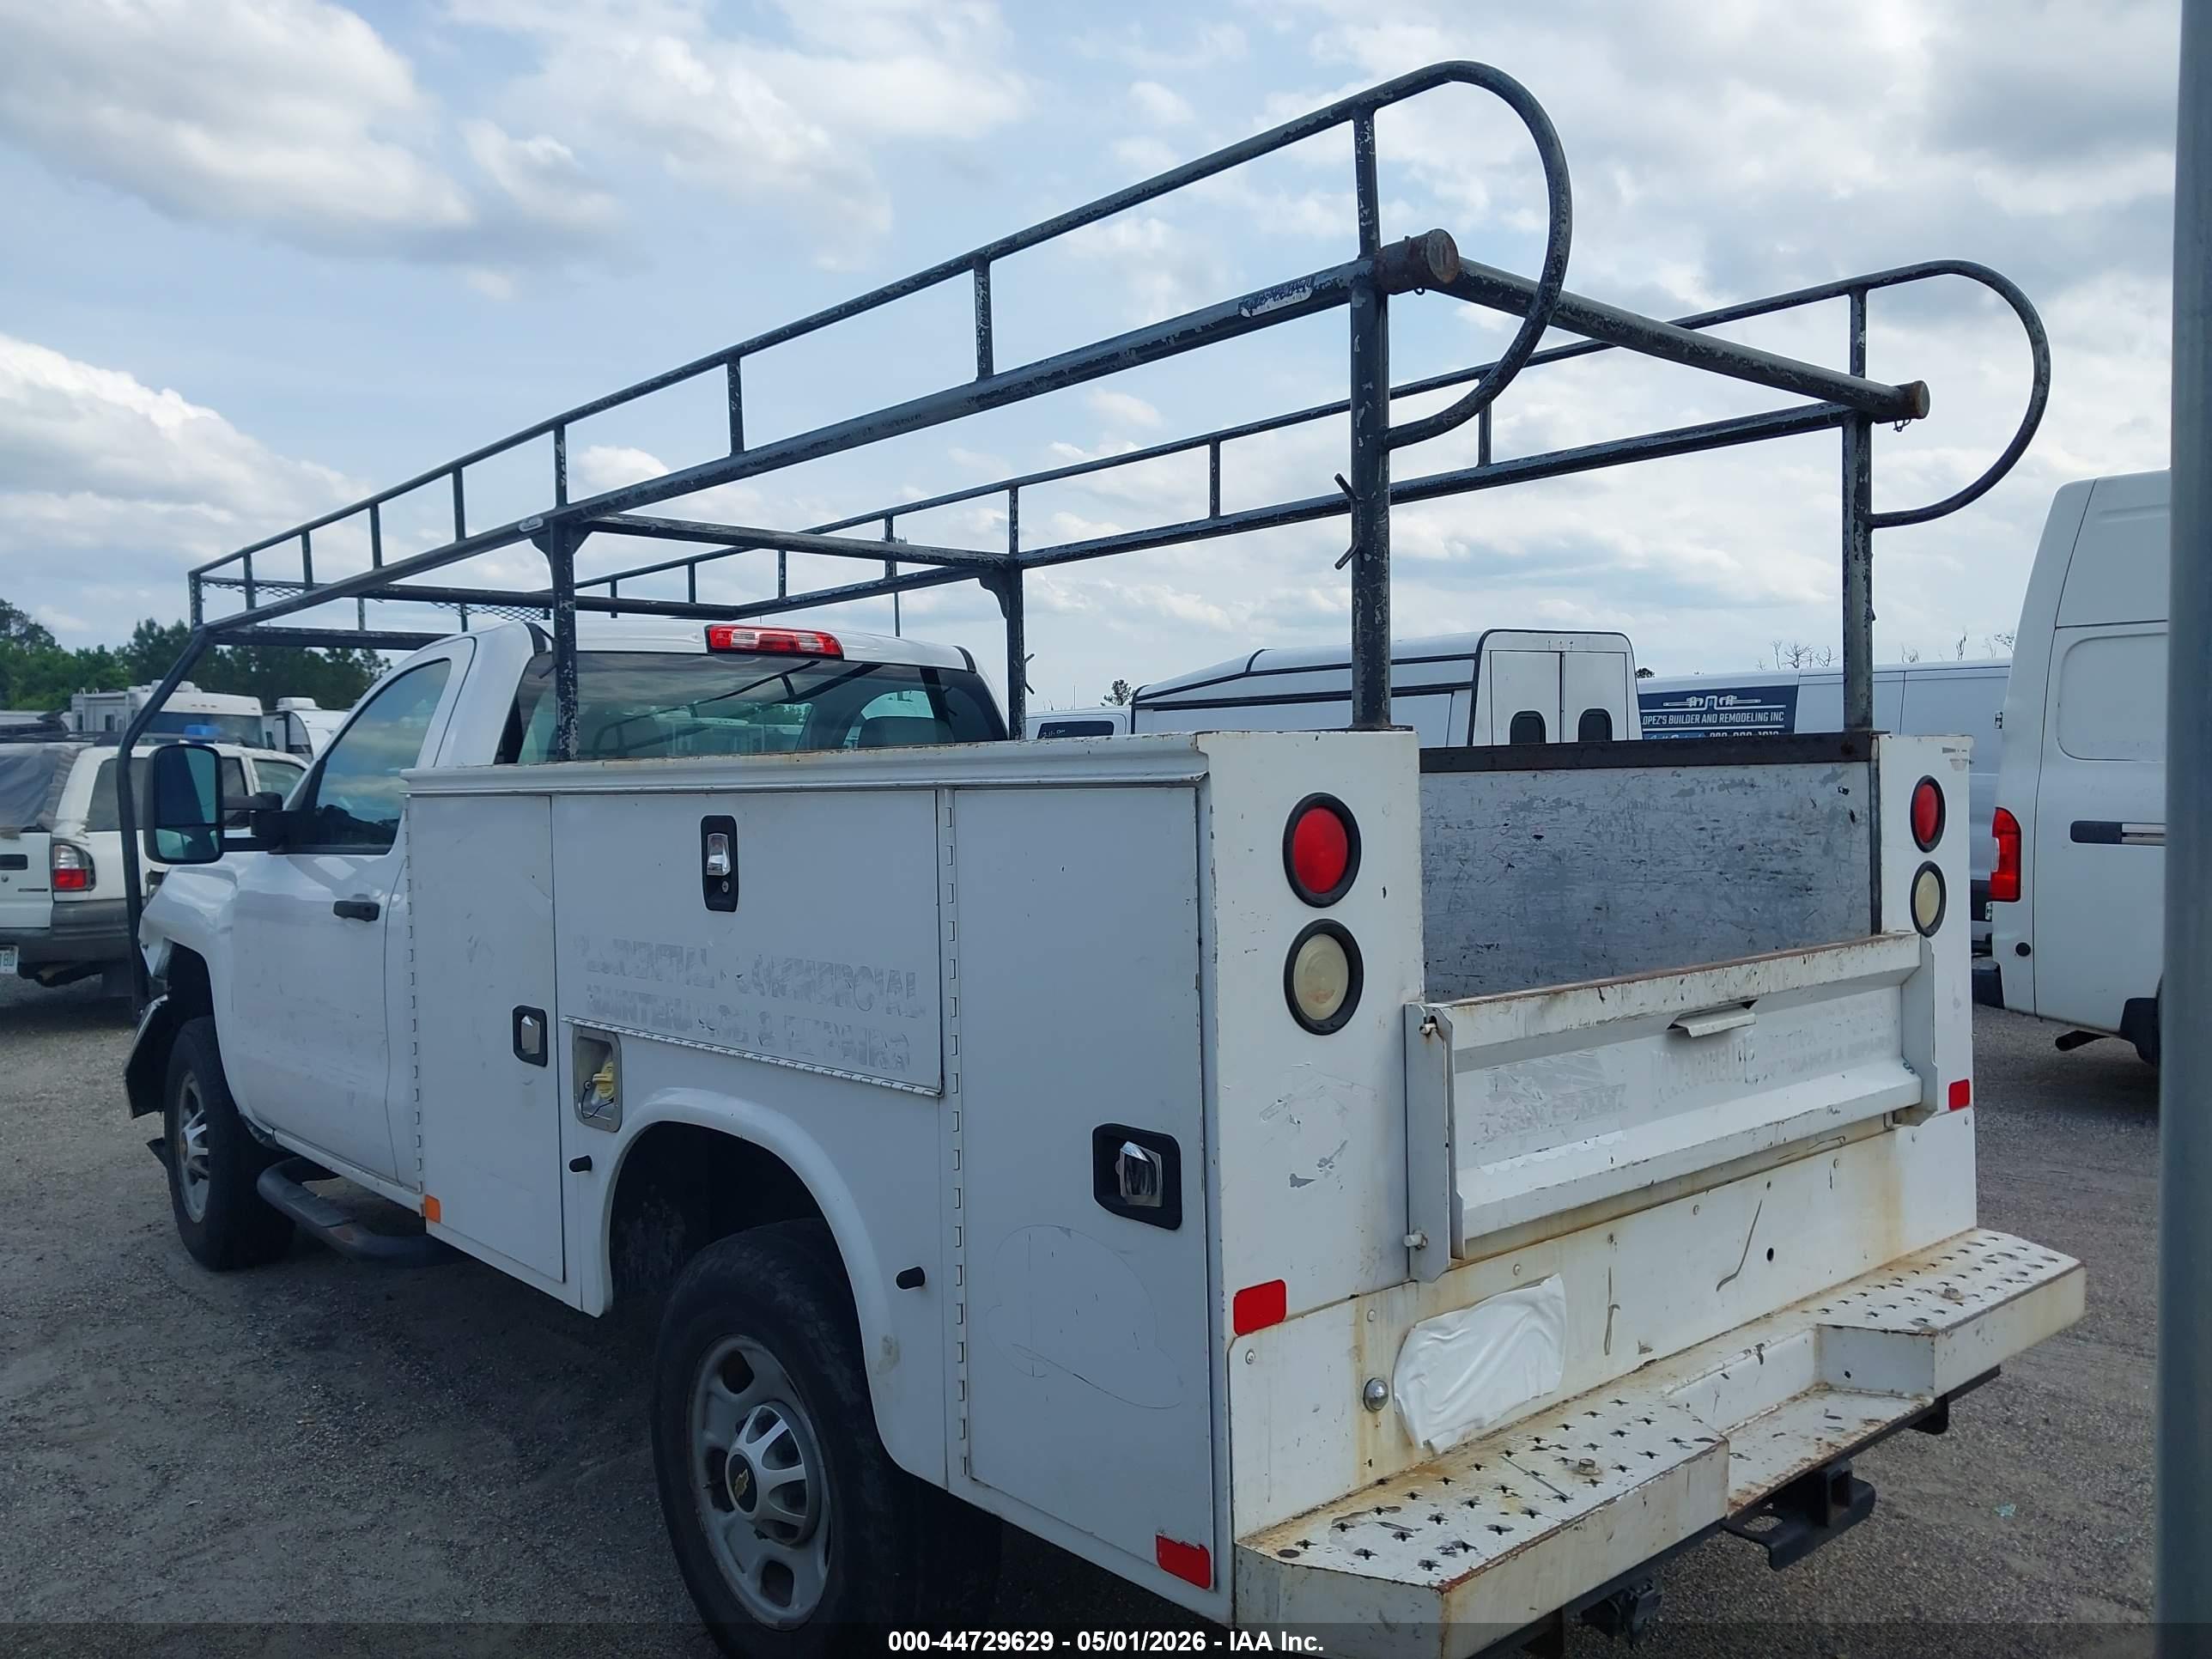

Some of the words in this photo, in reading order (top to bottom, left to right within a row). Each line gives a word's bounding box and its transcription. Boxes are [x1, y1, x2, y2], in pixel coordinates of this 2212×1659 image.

[1642, 715, 1668, 726] OPEZ'S
[1668, 714, 1700, 725] BUILDER
[1701, 713, 1718, 724] AND
[1719, 712, 1769, 723] REMODELING
[1770, 711, 1784, 722] INC
